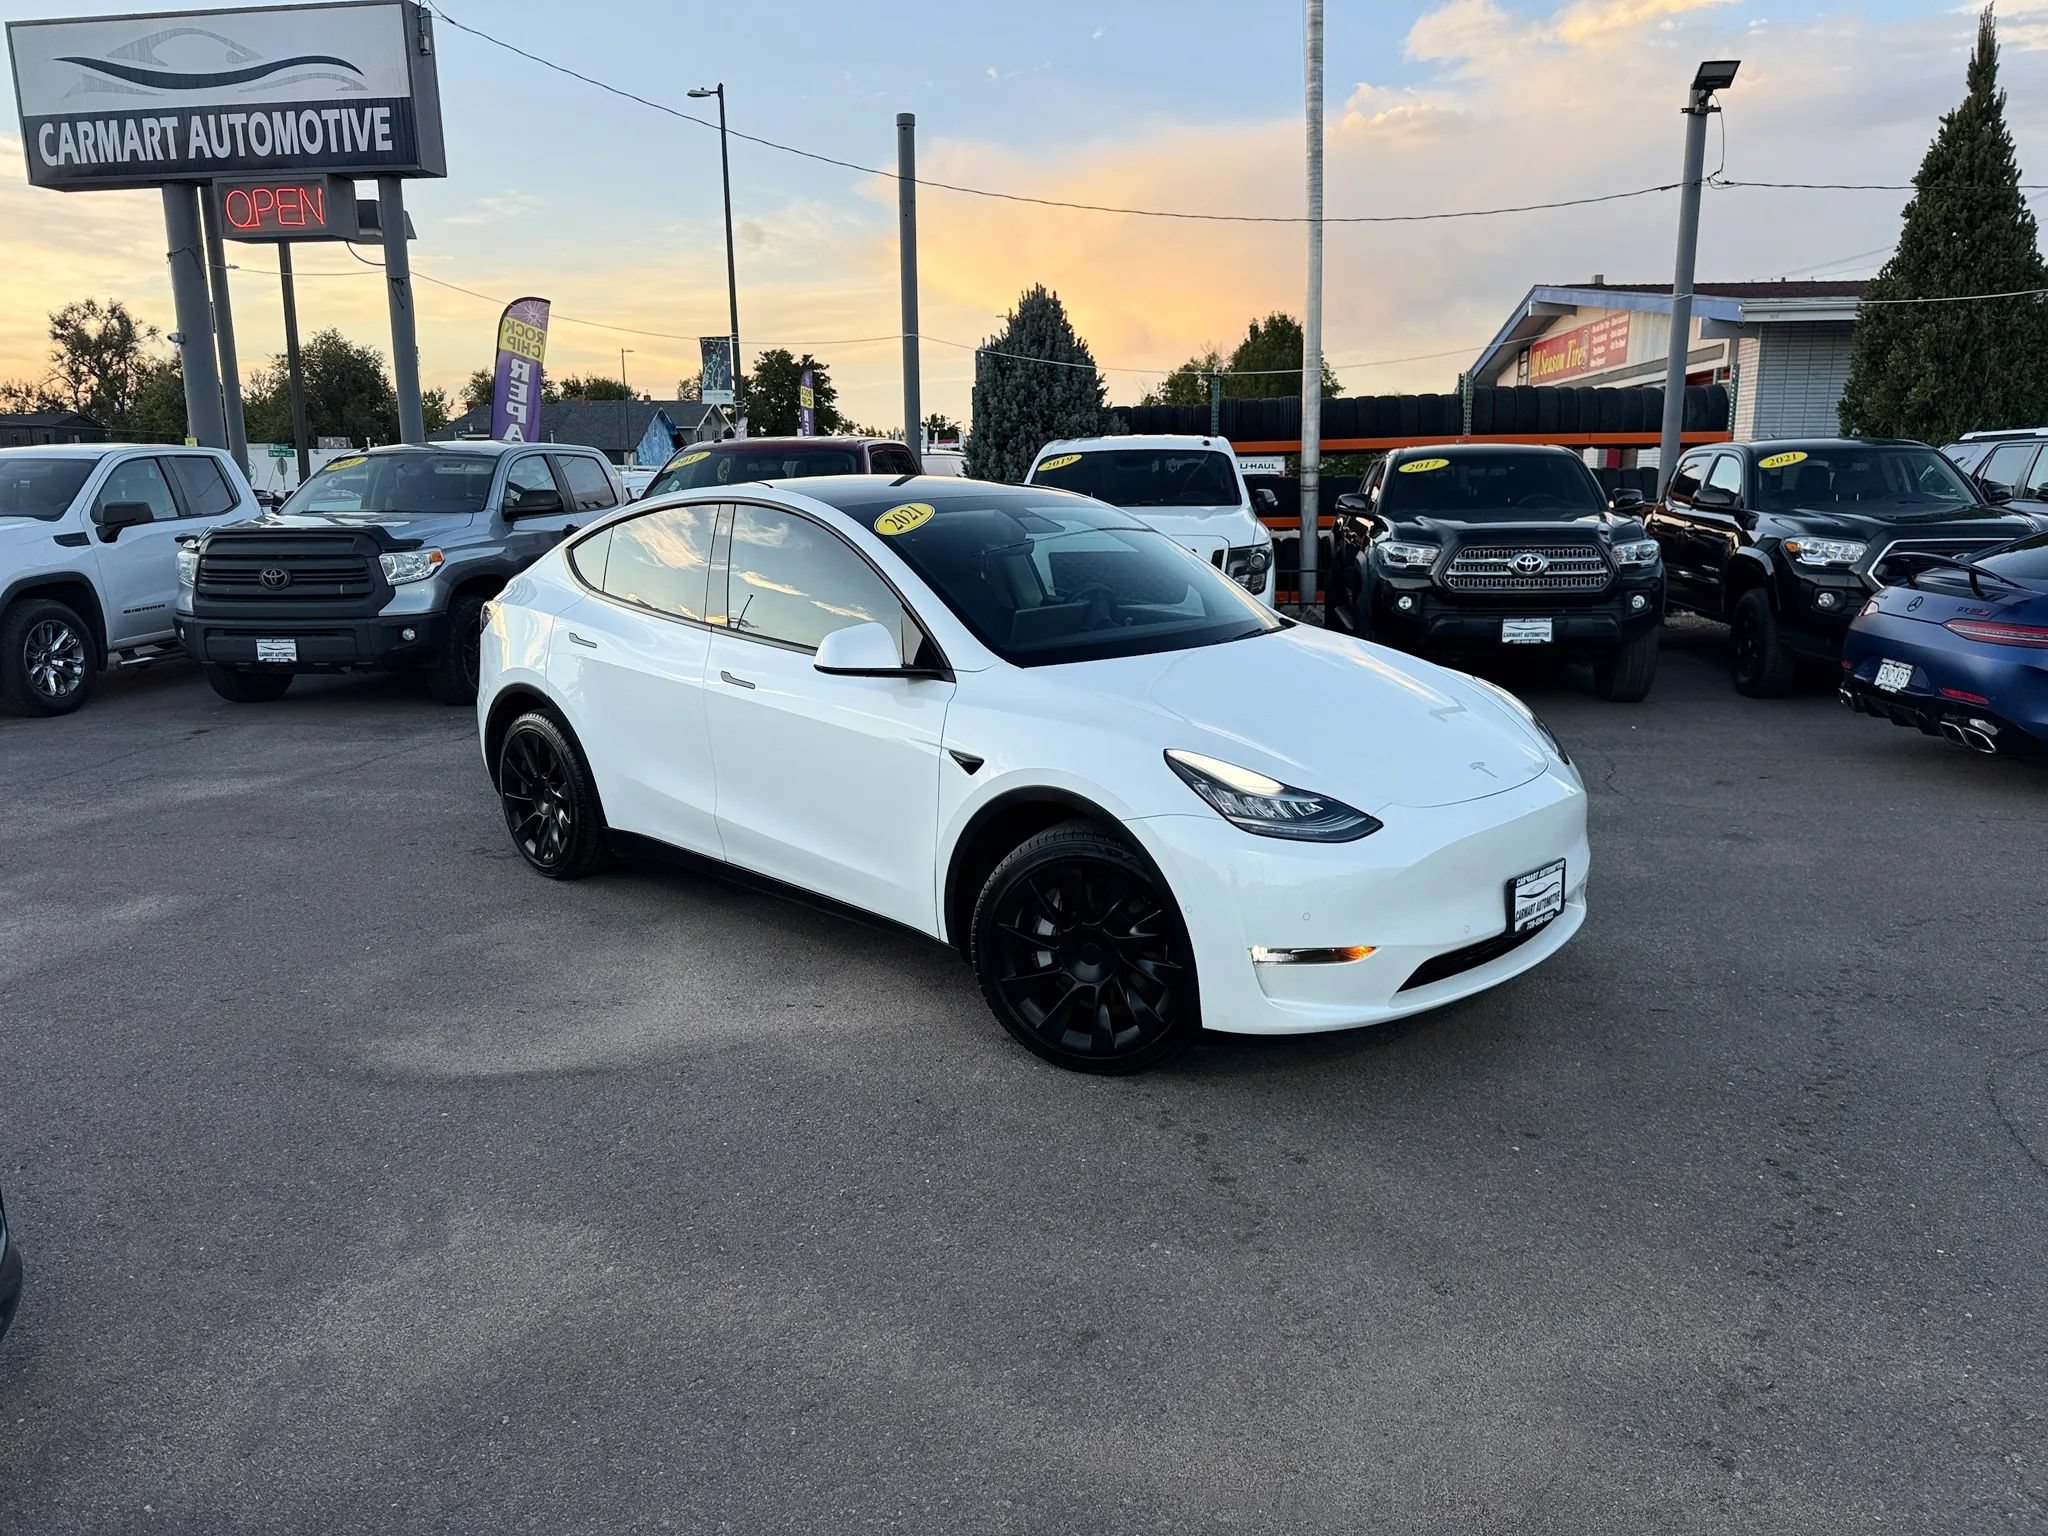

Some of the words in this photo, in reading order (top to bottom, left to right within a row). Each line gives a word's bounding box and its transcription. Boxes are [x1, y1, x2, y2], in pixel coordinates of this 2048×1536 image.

[38, 116, 178, 166] CARMART
[188, 107, 393, 159] AUTOMOTIVE
[225, 188, 325, 228] OPEN
[1540, 349, 1565, 375] Season
[1045, 455, 1074, 469] 2019
[1407, 460, 1440, 471] 2017
[1769, 453, 1797, 466] 2021
[885, 505, 925, 531] 2021
[1515, 902, 1536, 922] CARMART
